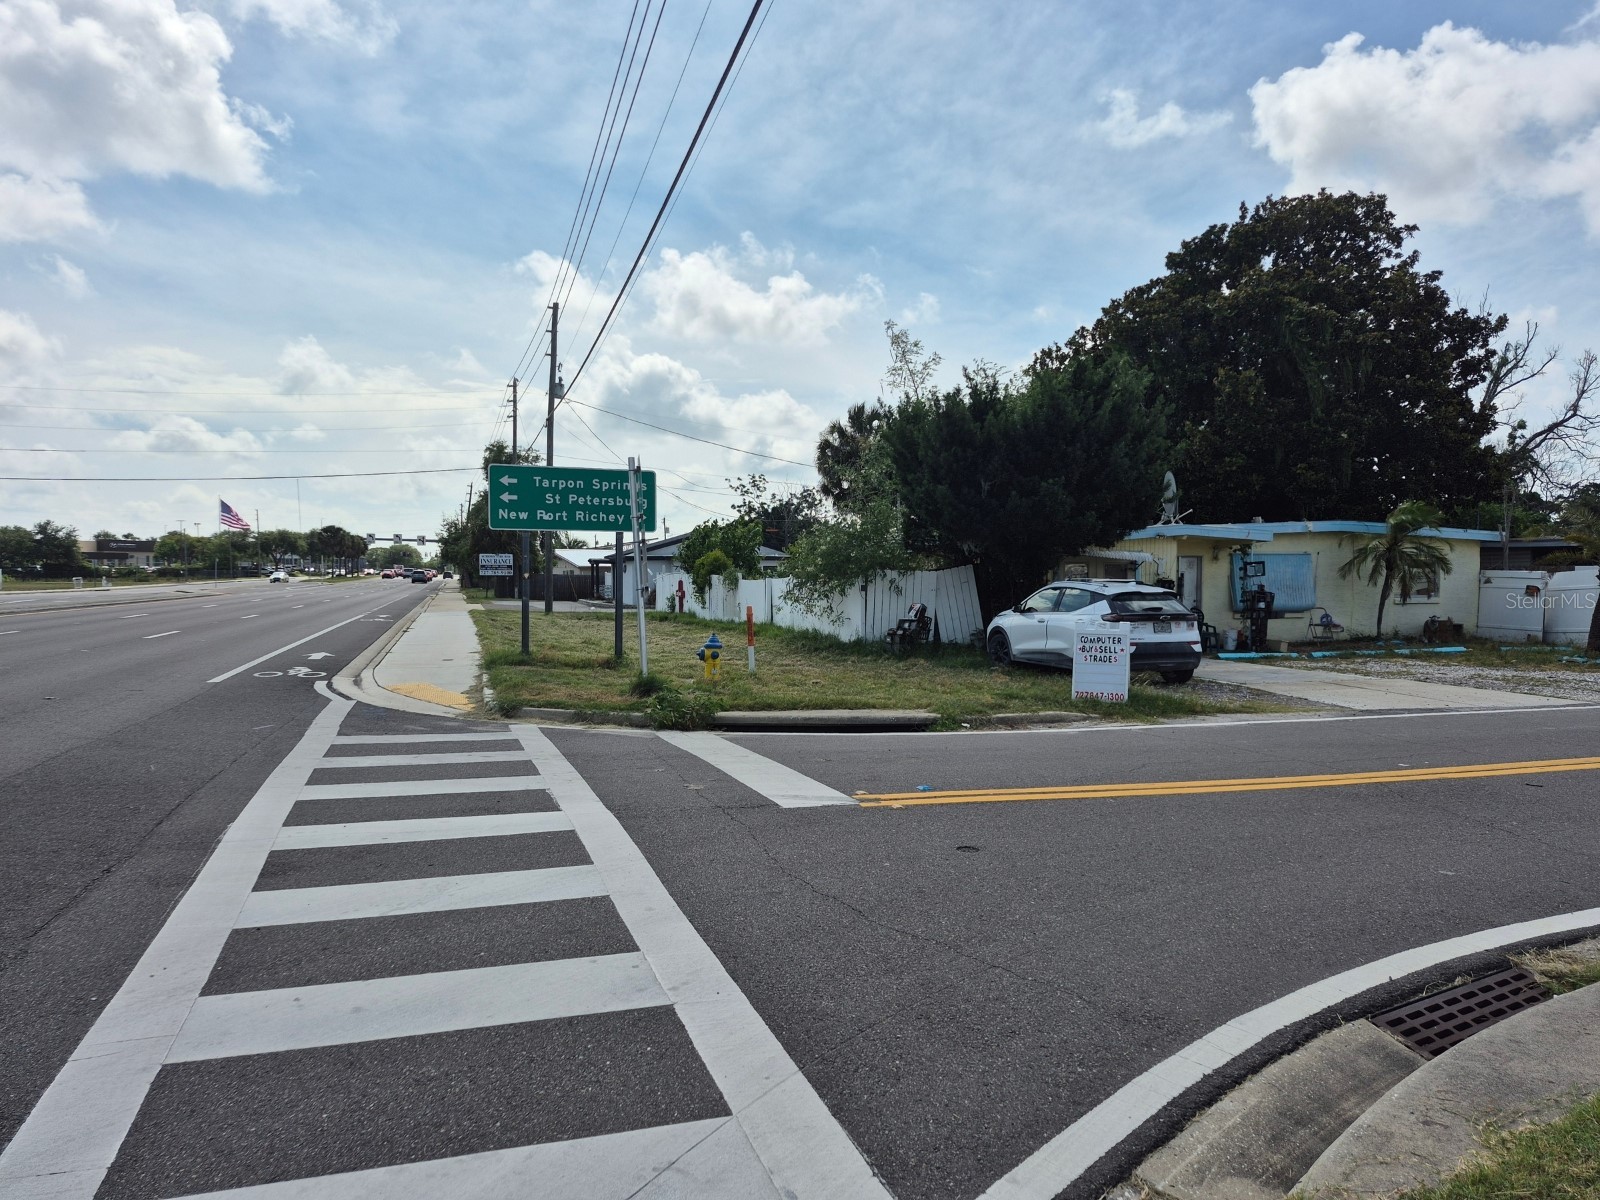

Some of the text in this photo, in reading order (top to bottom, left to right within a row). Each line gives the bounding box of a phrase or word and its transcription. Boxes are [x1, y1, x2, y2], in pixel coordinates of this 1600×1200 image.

[533, 476, 584, 490] Tarpon
[545, 494, 561, 504] St
[498, 508, 625, 524] New Port Richey
[1080, 636, 1122, 645] COMPUTER
